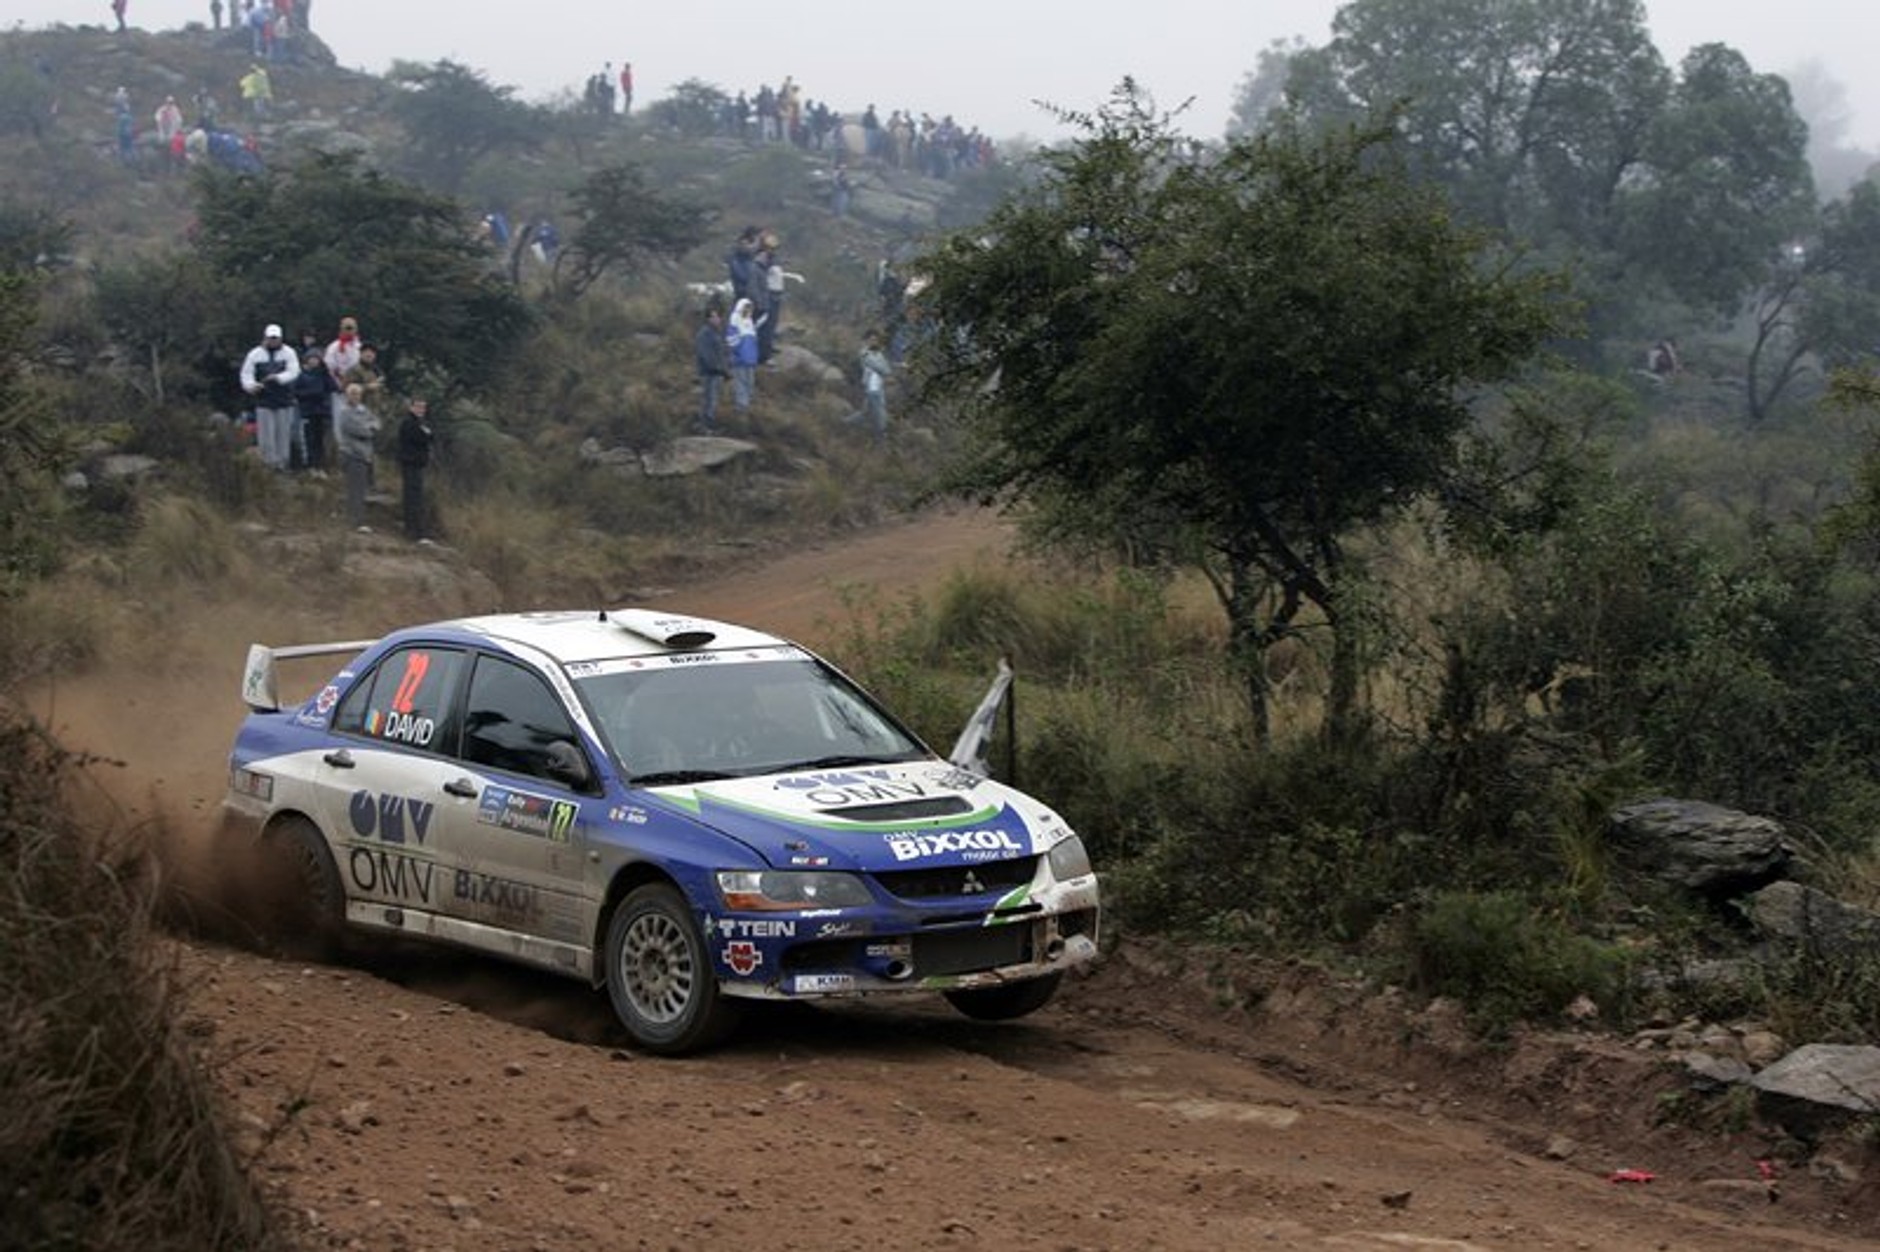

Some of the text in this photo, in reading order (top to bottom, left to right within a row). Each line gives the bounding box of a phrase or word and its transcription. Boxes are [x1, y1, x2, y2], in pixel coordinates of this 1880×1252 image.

[384, 711, 434, 745] DAVID
[806, 782, 927, 805] OMV
[889, 829, 1022, 861] BiXXOL
[350, 847, 435, 904] OMV
[738, 920, 796, 937] TEIN
